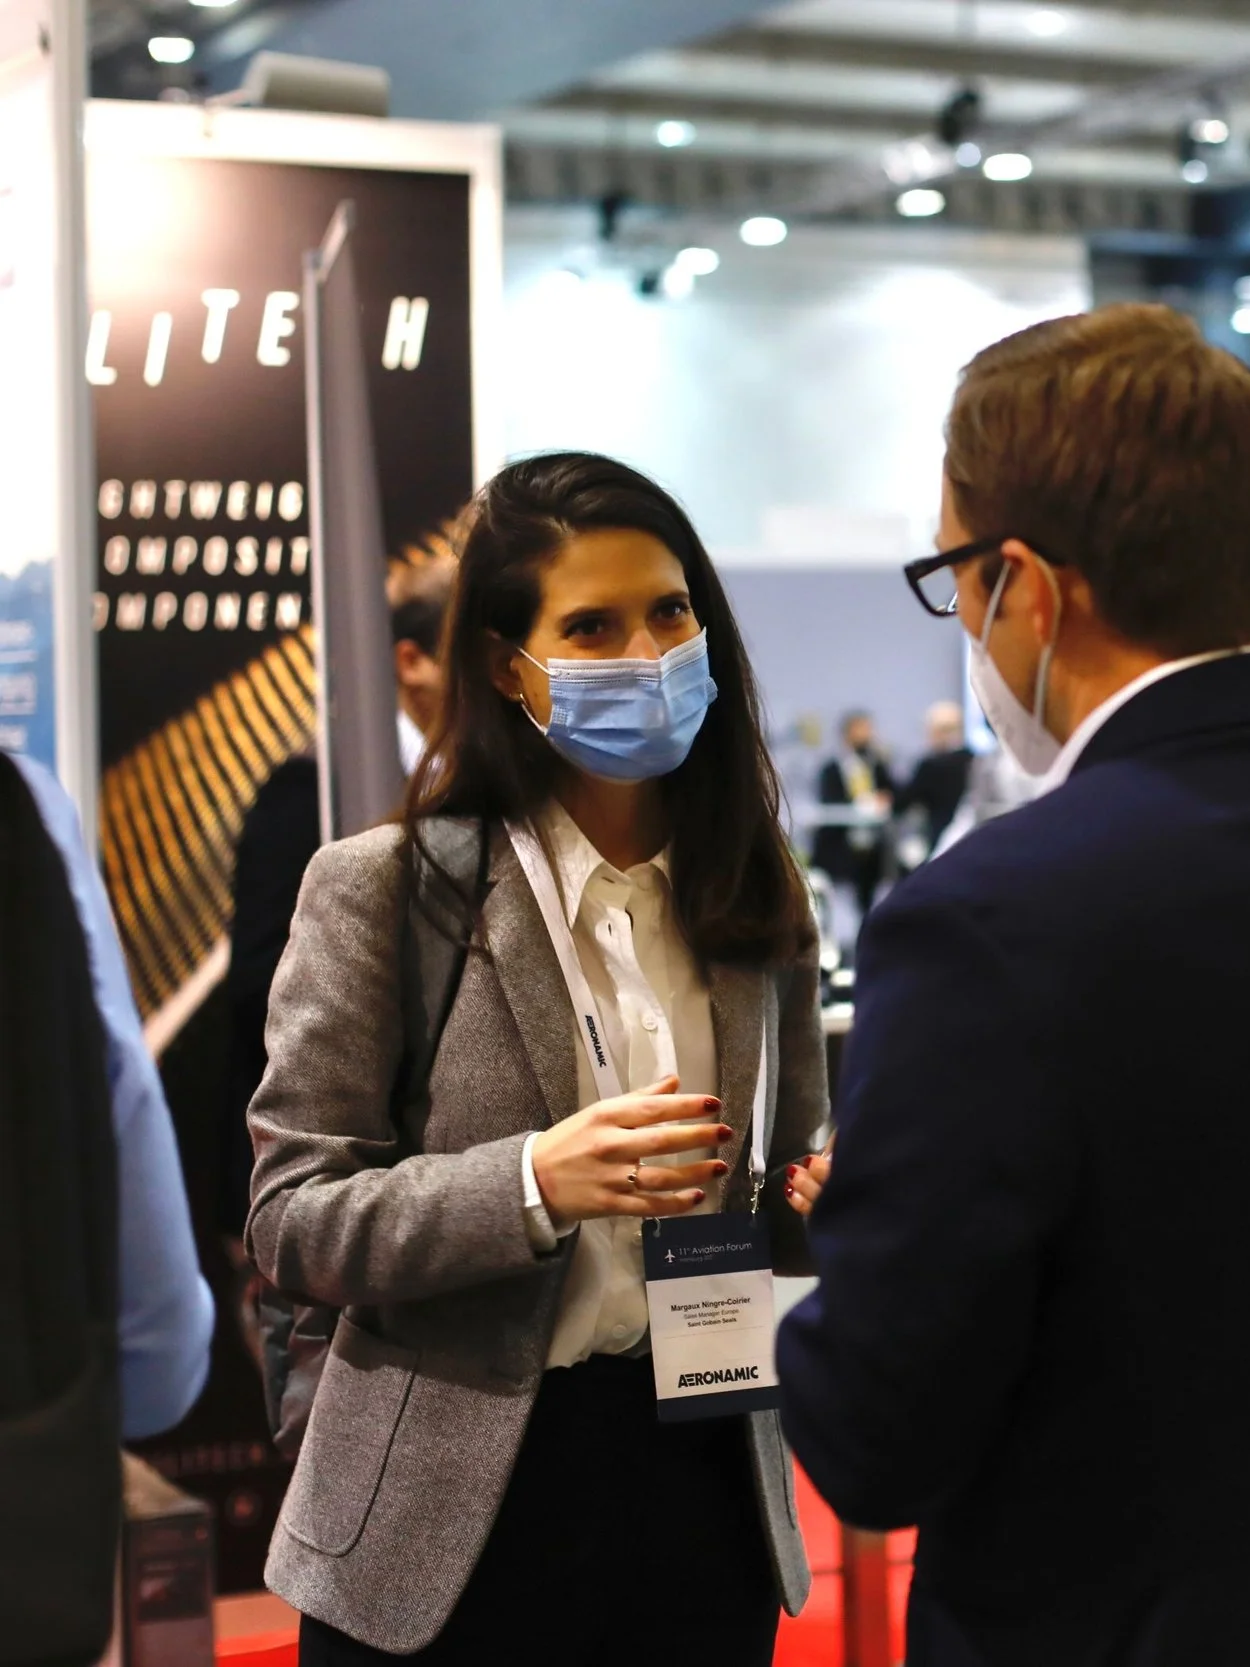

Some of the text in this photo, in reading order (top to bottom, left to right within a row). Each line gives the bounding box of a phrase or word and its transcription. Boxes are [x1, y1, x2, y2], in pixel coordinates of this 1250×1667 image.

[85, 287, 430, 387] LITEH
[584, 1014, 607, 1068] AERONAMIC
[692, 1244, 724, 1255] Aviation
[726, 1242, 752, 1251] Forum
[671, 1304, 700, 1312] Margaux
[678, 1366, 759, 1389] AERONAMIC
